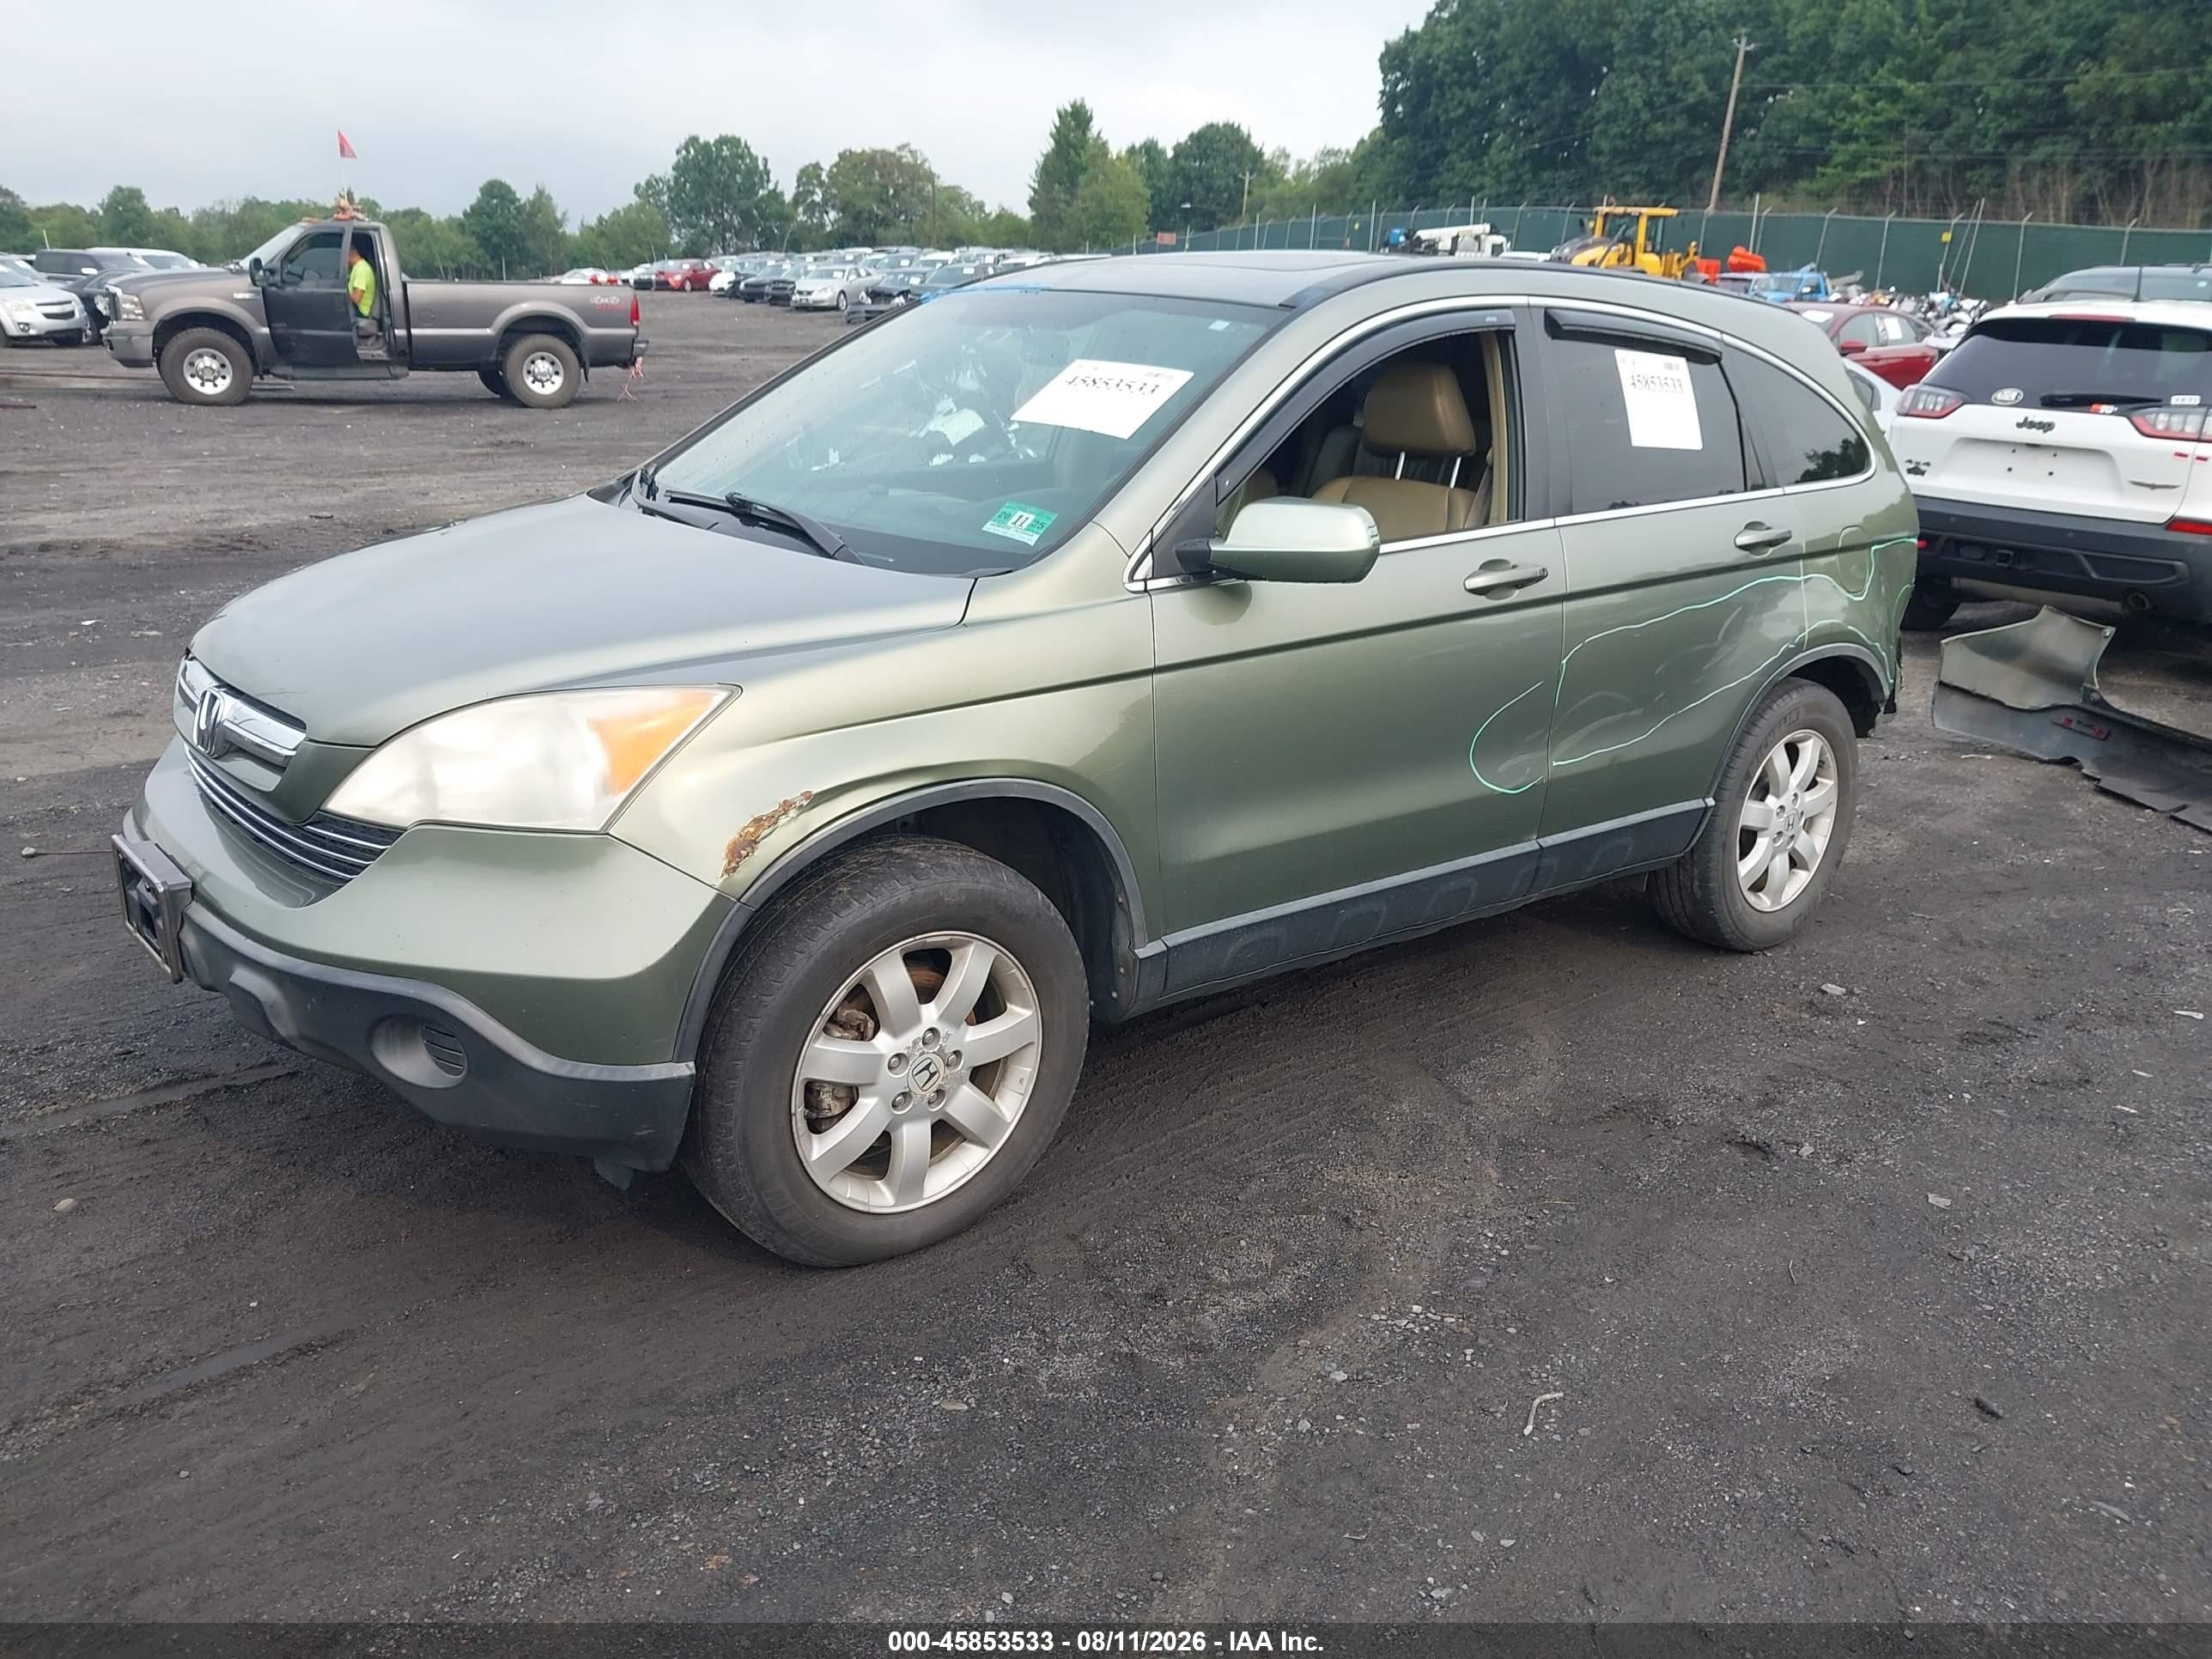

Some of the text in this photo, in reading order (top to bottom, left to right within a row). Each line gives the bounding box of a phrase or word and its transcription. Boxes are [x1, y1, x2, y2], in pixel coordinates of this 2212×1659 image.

[1065, 375, 1160, 394] 45853533
[1630, 374, 1684, 394] 45853533
[2015, 416, 2056, 434] Jeep
[1012, 514, 1030, 528] 11
[1030, 520, 1045, 530] 25
